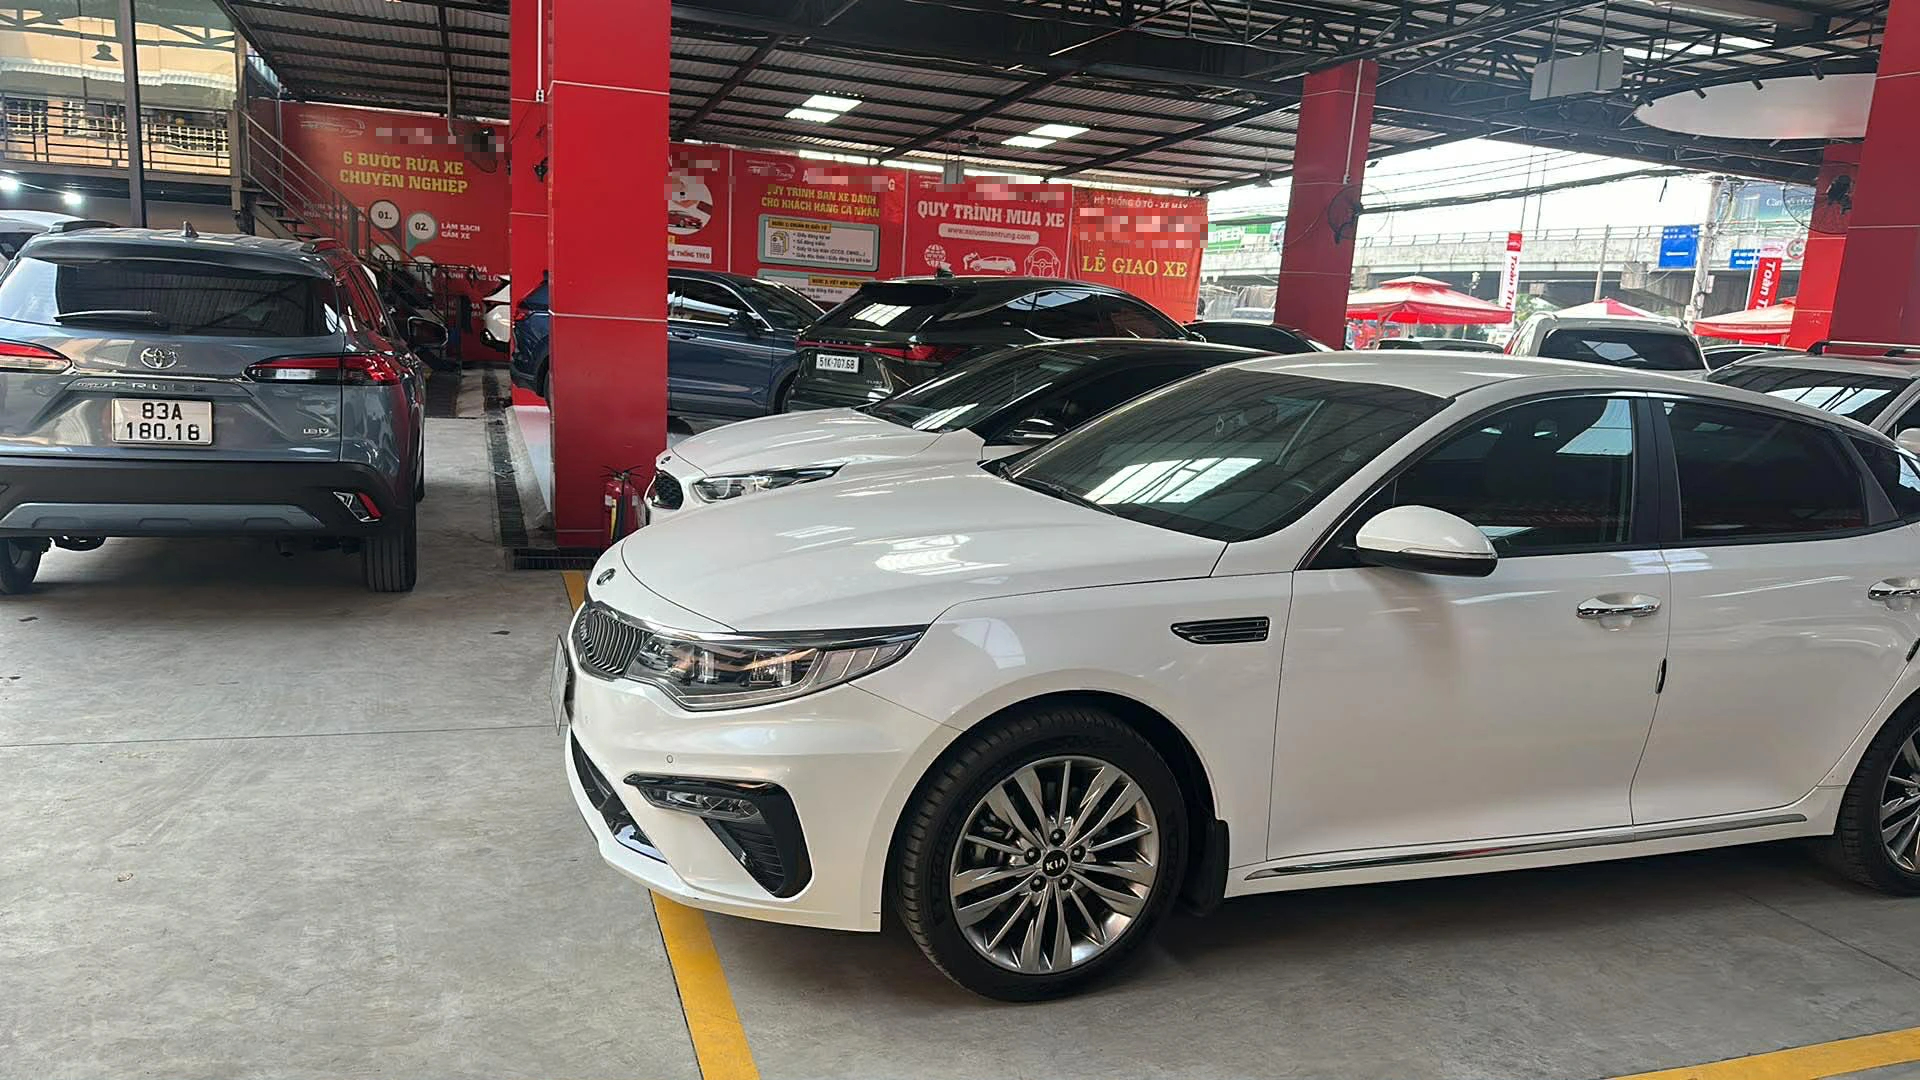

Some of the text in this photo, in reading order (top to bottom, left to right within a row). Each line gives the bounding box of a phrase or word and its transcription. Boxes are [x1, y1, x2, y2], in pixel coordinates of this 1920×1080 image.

[343, 151, 353, 165] 6
[444, 161, 464, 176] XE
[340, 170, 469, 196] CHUYÊN NGHIỆP
[378, 210, 392, 220] 01.
[917, 200, 1065, 228] QUY TRÌNH MUA XE
[414, 222, 429, 232] 02.
[460, 232, 471, 240] XE
[1081, 249, 1188, 278] LỄ GIAO XE
[1759, 261, 1777, 297] Toàn
[141, 402, 183, 421] 83A
[126, 421, 200, 442] 180.18
[1046, 858, 1067, 871] KIA
